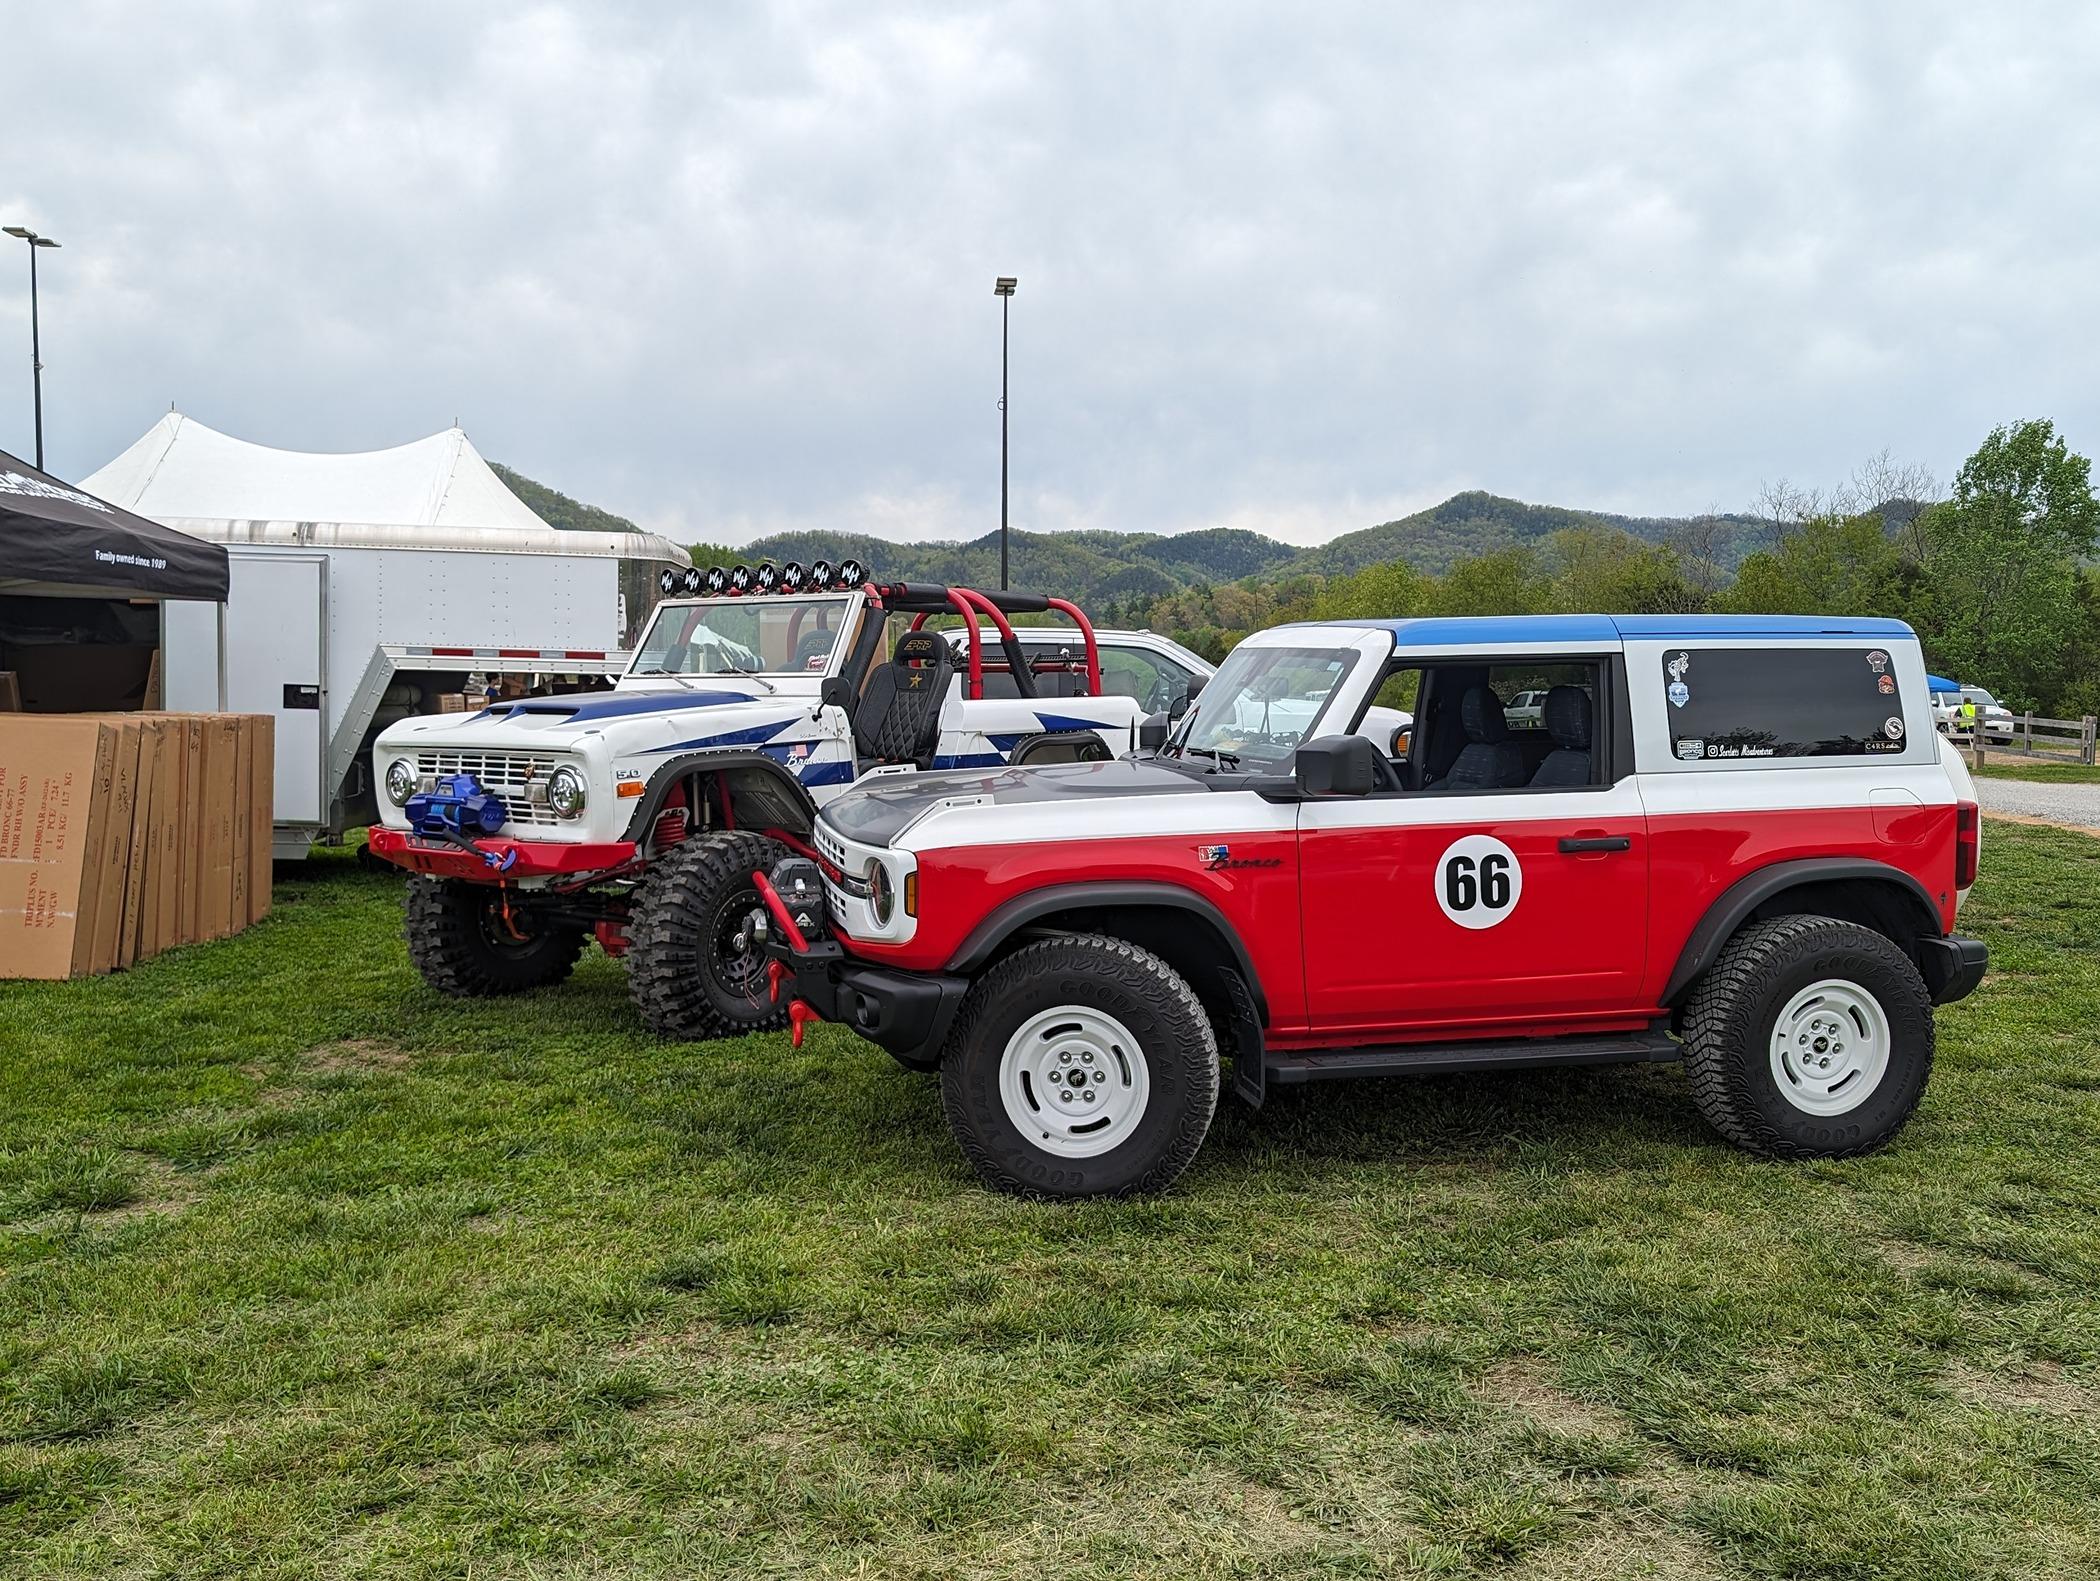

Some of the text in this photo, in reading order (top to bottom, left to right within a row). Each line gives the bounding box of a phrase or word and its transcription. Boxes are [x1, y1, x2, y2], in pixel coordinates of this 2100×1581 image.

[95, 549, 167, 569] Family owned since 1989
[64, 772, 73, 786] KG
[616, 768, 641, 780] 5.0
[19, 774, 29, 796] ASSY
[6, 788, 15, 810] 66-77
[61, 791, 71, 807] 11.7
[1, 811, 12, 844] BRONC
[14, 818, 23, 831] RH
[10, 833, 21, 859] FNDR
[56, 834, 66, 850] 8.51
[1204, 852, 1284, 871] Bronco
[29, 869, 39, 887] NO.
[1446, 853, 1511, 911] 66
[25, 887, 37, 928] TRIPLUS
